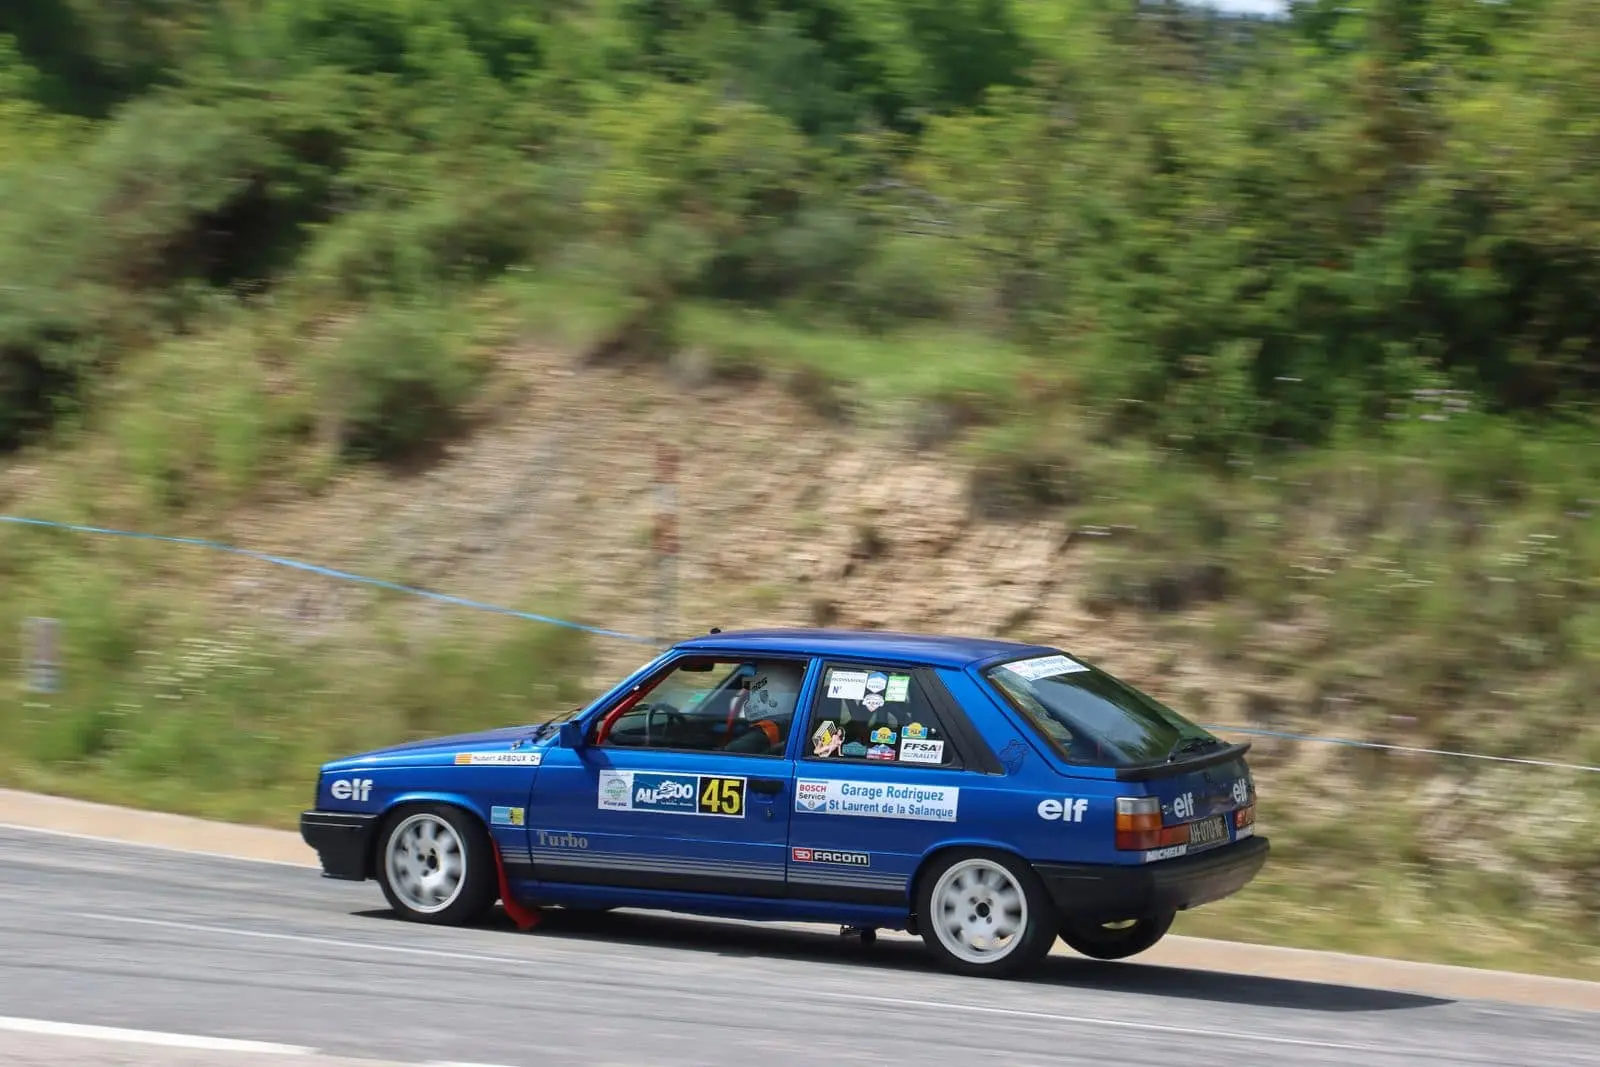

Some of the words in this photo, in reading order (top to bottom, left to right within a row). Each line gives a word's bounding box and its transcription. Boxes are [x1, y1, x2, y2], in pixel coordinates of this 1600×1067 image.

[903, 742, 937, 752] FFSA
[331, 778, 373, 801] elf
[702, 779, 741, 814] 45
[798, 792, 826, 801] Service
[799, 784, 827, 793] BOSCH
[841, 783, 883, 801] Garage
[886, 785, 945, 802] Rodriguez
[1232, 778, 1248, 803] elf
[828, 800, 840, 811] St
[842, 800, 880, 813] Laurent
[881, 802, 894, 814] de
[897, 803, 906, 815] la
[908, 804, 954, 819] Salanque
[1037, 798, 1088, 822] elf
[1173, 791, 1194, 818] elf
[537, 829, 588, 848] Turbo
[814, 851, 867, 864] FACOM
